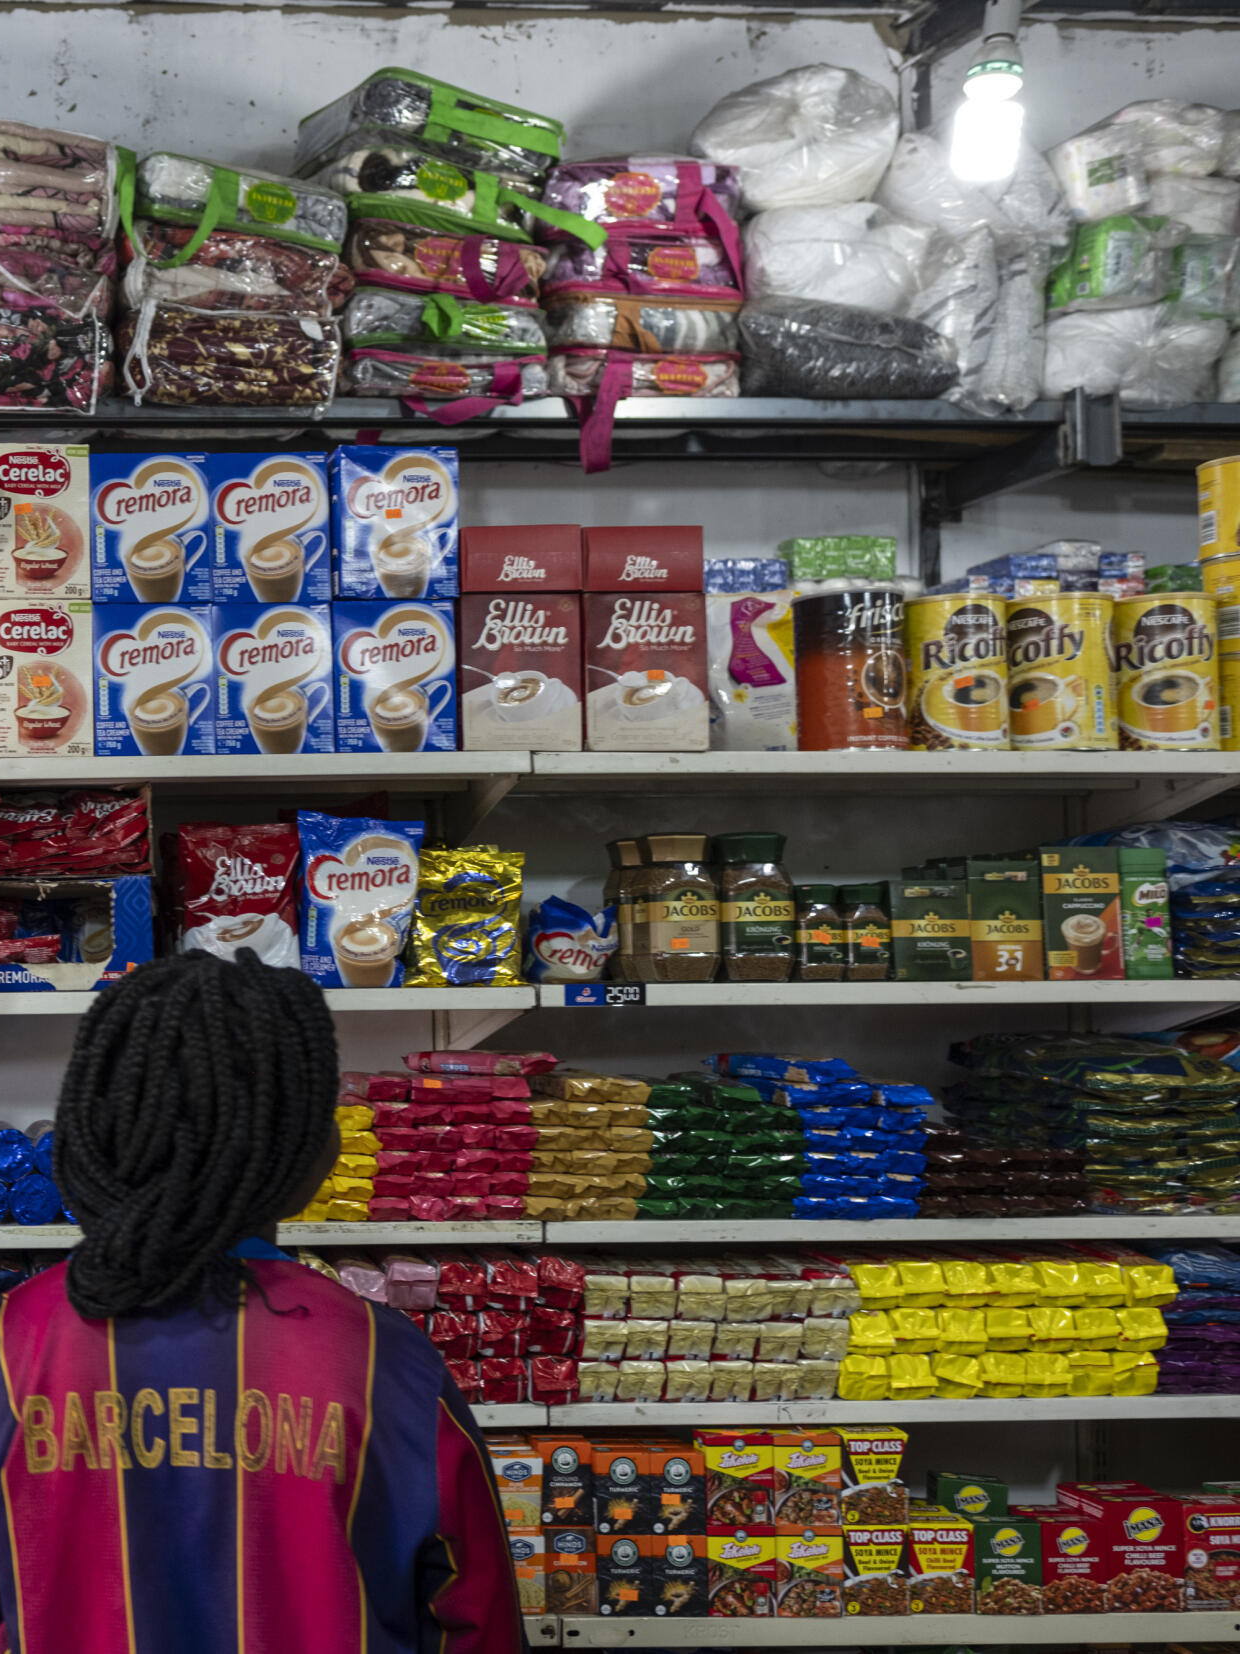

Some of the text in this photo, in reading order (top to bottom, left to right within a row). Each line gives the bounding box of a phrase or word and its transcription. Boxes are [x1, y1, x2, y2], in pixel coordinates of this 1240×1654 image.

[97, 481, 192, 525] Cremora
[217, 481, 311, 525] Cremora
[347, 475, 440, 519] Cremora
[496, 566, 546, 582] Brown
[503, 555, 535, 570] Ellis
[618, 566, 668, 582] Brown
[626, 555, 658, 570] Ellis
[485, 598, 546, 627] Ellis
[611, 598, 672, 627] Ellis
[0, 623, 68, 640] Cerelac
[472, 619, 569, 651] Brown
[597, 618, 695, 650] Brown
[100, 633, 195, 677] Cremora
[219, 632, 315, 676] Cremora
[340, 630, 436, 675] Cremora
[215, 857, 264, 880] Ellis
[307, 854, 411, 900] Cremora
[211, 874, 285, 900] Brown
[1056, 877, 1110, 890] JACOBS
[663, 904, 717, 919] JACOBS
[736, 906, 791, 919] JACOBS
[910, 923, 957, 934] JACOBS
[986, 924, 1030, 935] JACOBS
[24, 1387, 346, 1484] BARCELONA
[849, 1441, 903, 1452] TOP CLASS
[849, 1531, 903, 1543] TOP CLASS
[913, 1530, 968, 1542] TOP CLASS
